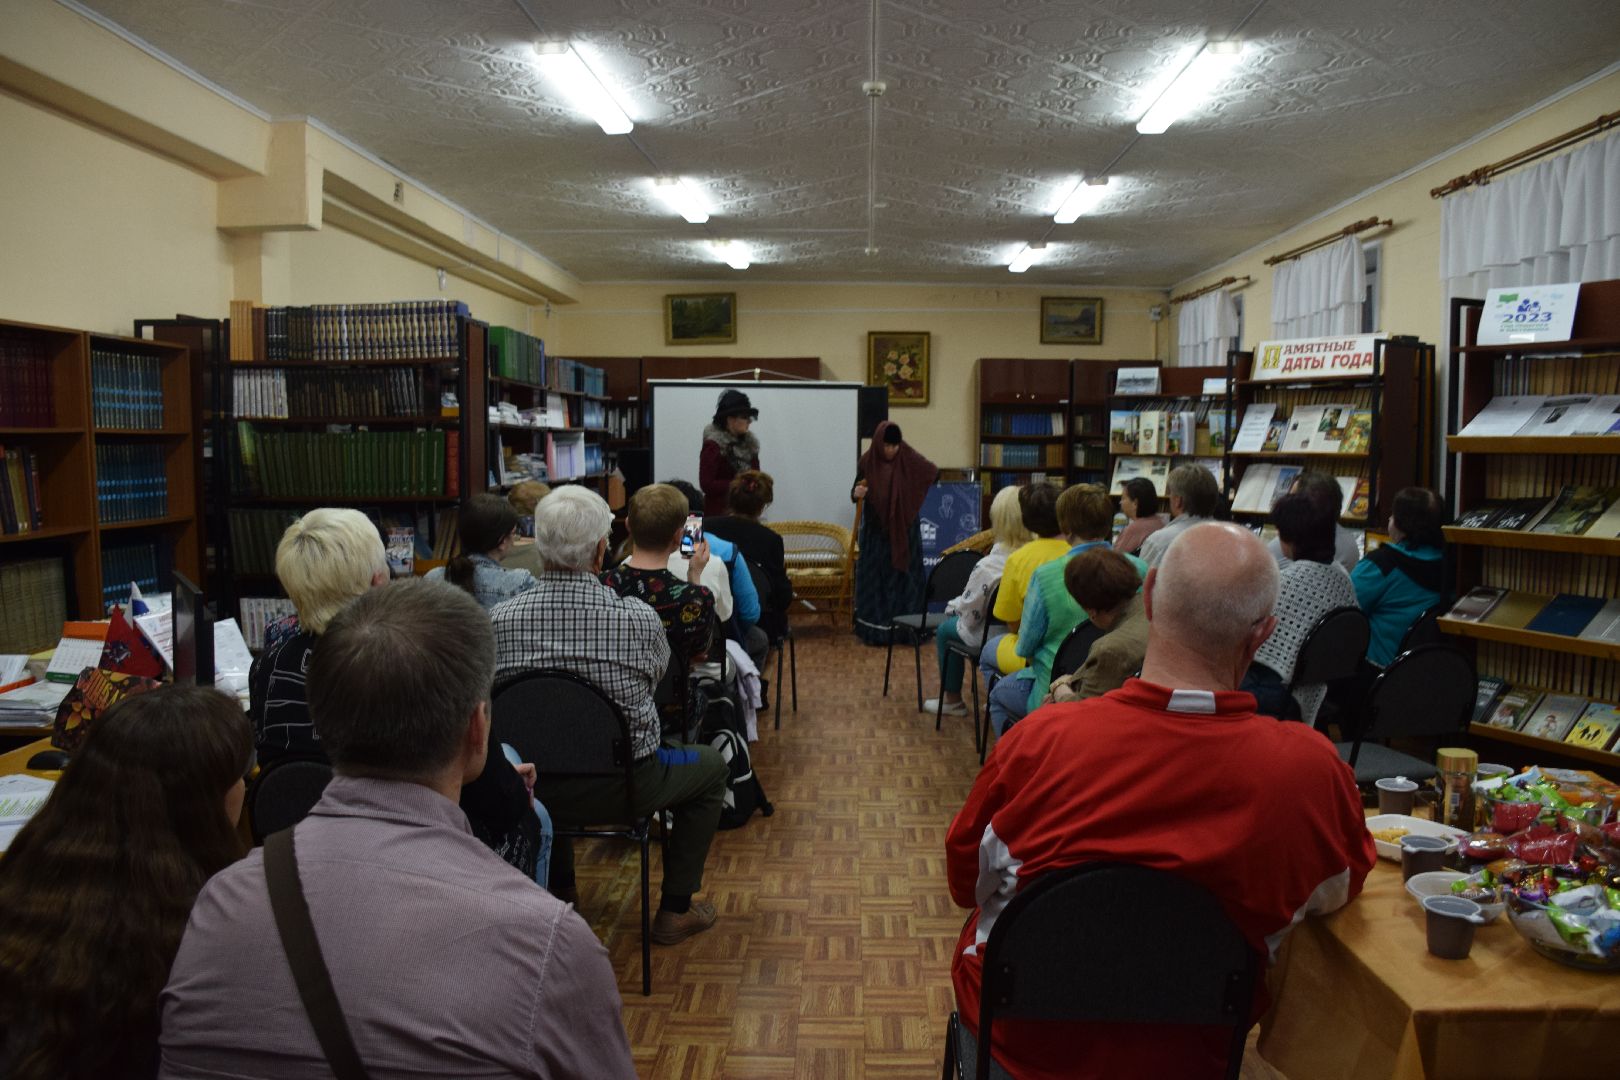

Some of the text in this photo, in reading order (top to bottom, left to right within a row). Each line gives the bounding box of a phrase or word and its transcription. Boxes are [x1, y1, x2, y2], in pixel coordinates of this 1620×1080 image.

[1503, 312, 1552, 322] 2023
[1263, 341, 1357, 369] ПАМЯТНЫЕ
[1281, 352, 1373, 373] ДАТЫ ГОДА
